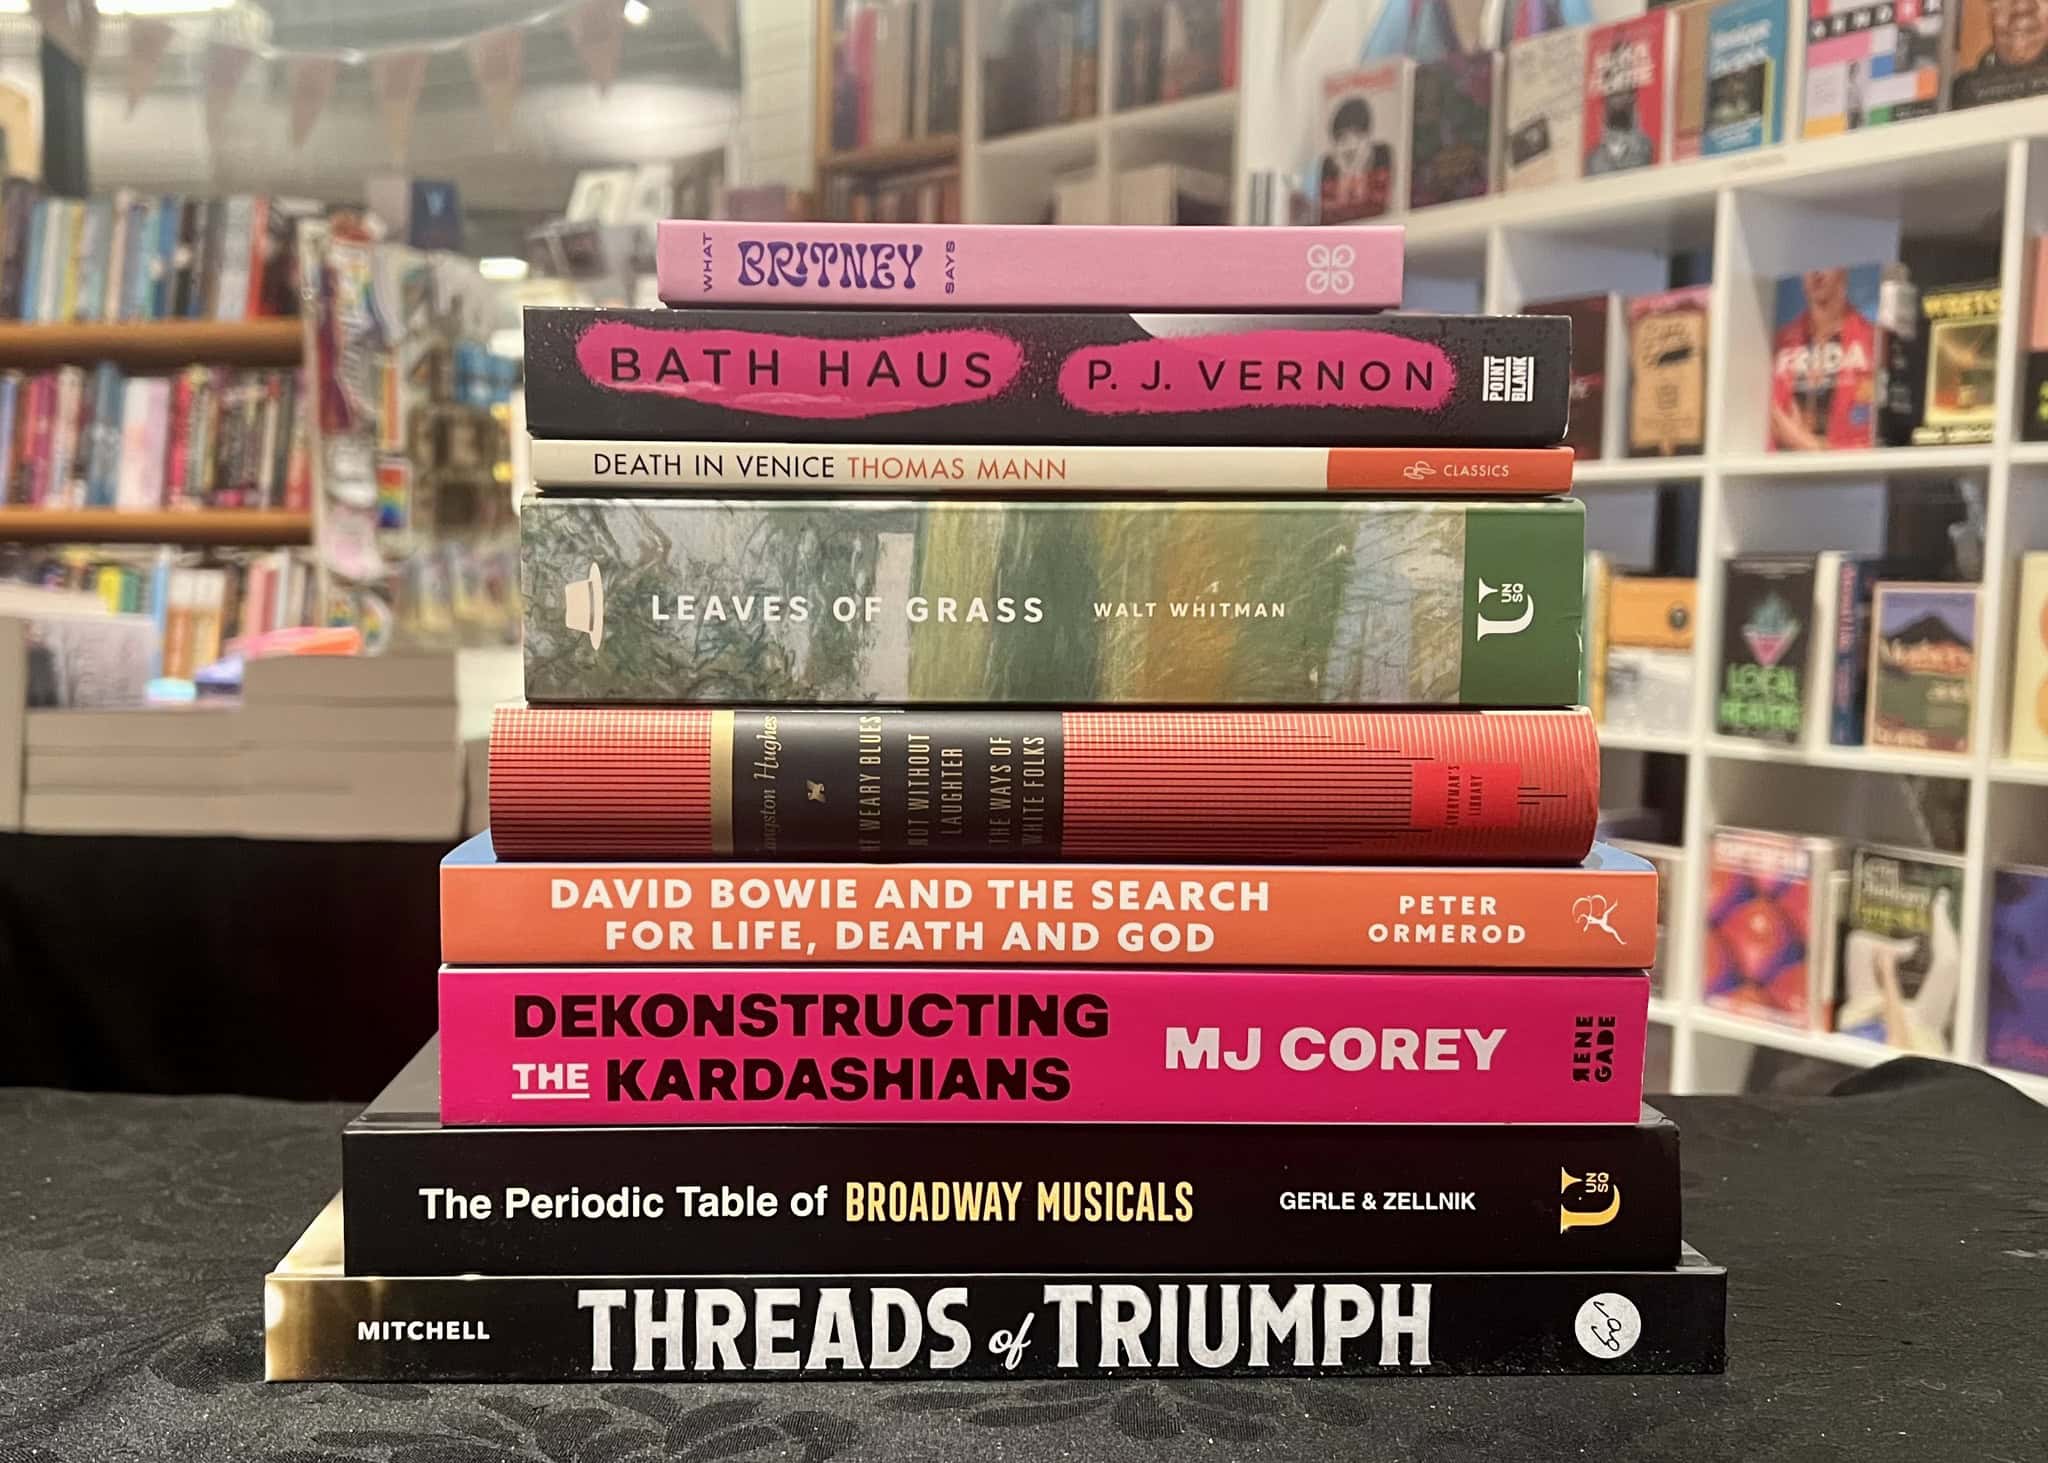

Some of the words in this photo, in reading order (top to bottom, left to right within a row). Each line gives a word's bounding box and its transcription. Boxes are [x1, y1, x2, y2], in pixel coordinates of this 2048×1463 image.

[703, 233, 714, 293] WHAT
[737, 240, 924, 290] BRITNEY
[945, 240, 957, 295] SAYS
[611, 347, 780, 385] BATH
[819, 349, 992, 388] HAUS
[1087, 360, 1118, 391] P.
[1141, 360, 1172, 391] J.
[1199, 360, 1434, 392] VERNON
[1490, 357, 1504, 402] POINT
[1512, 356, 1527, 402] BLANK
[594, 453, 681, 476] DEATH
[695, 455, 723, 477] IN
[736, 455, 835, 479] VENICE
[847, 457, 964, 480] THOMAS
[977, 459, 1066, 482] MANN
[1443, 464, 1510, 478] CLASSICS
[651, 595, 809, 622] LEAVES
[832, 596, 881, 622] OF
[905, 597, 1044, 624] GRASS
[1093, 602, 1157, 618] WALT
[1170, 602, 1287, 618] WHITMAN
[754, 715, 783, 780] Hughes
[859, 715, 883, 765] BLUES
[989, 736, 1013, 756] OF
[1023, 736, 1046, 789] FOLKS
[907, 733, 931, 808] WITHOUT
[940, 748, 964, 836] LAUGHTER
[989, 764, 1012, 811] WAYS
[859, 774, 882, 829] WEARY
[1023, 796, 1046, 847] WHITE
[989, 816, 1012, 846] THE
[551, 879, 692, 909] DAVID
[711, 878, 857, 911] BOWIE
[874, 879, 974, 911] AND
[988, 880, 1074, 910] THE
[1091, 880, 1270, 913] SEARCH
[1399, 895, 1497, 916] PETER
[606, 920, 695, 951] FOR
[711, 920, 817, 956] LIFE,
[835, 920, 984, 951] DEATH
[1001, 921, 1100, 953] AND
[1117, 922, 1216, 953] GOD
[1368, 923, 1527, 945] ORMEROD
[514, 992, 1110, 1040] DEKONSTRUCTING
[1165, 1026, 1262, 1071] MJ
[1279, 1027, 1508, 1072] COREY
[1594, 1016, 1616, 1083] GADE
[512, 1063, 589, 1091] THE
[607, 1057, 1072, 1102] KARDASHIANS
[418, 1187, 492, 1220] The
[506, 1185, 665, 1220] Periodic
[675, 1184, 778, 1219] Table
[790, 1184, 829, 1217] of
[845, 1180, 1023, 1223] BROADWAY
[1037, 1180, 1194, 1223] MUSICALS
[1279, 1191, 1356, 1211] GERLE
[1361, 1191, 1378, 1211] &
[1382, 1191, 1477, 1211] ZELLNIK
[357, 1320, 491, 1341] MITCHELL
[577, 1286, 972, 1371] THREADS
[988, 1311, 1035, 1371] of
[1043, 1283, 1433, 1368] TRIUMPH
